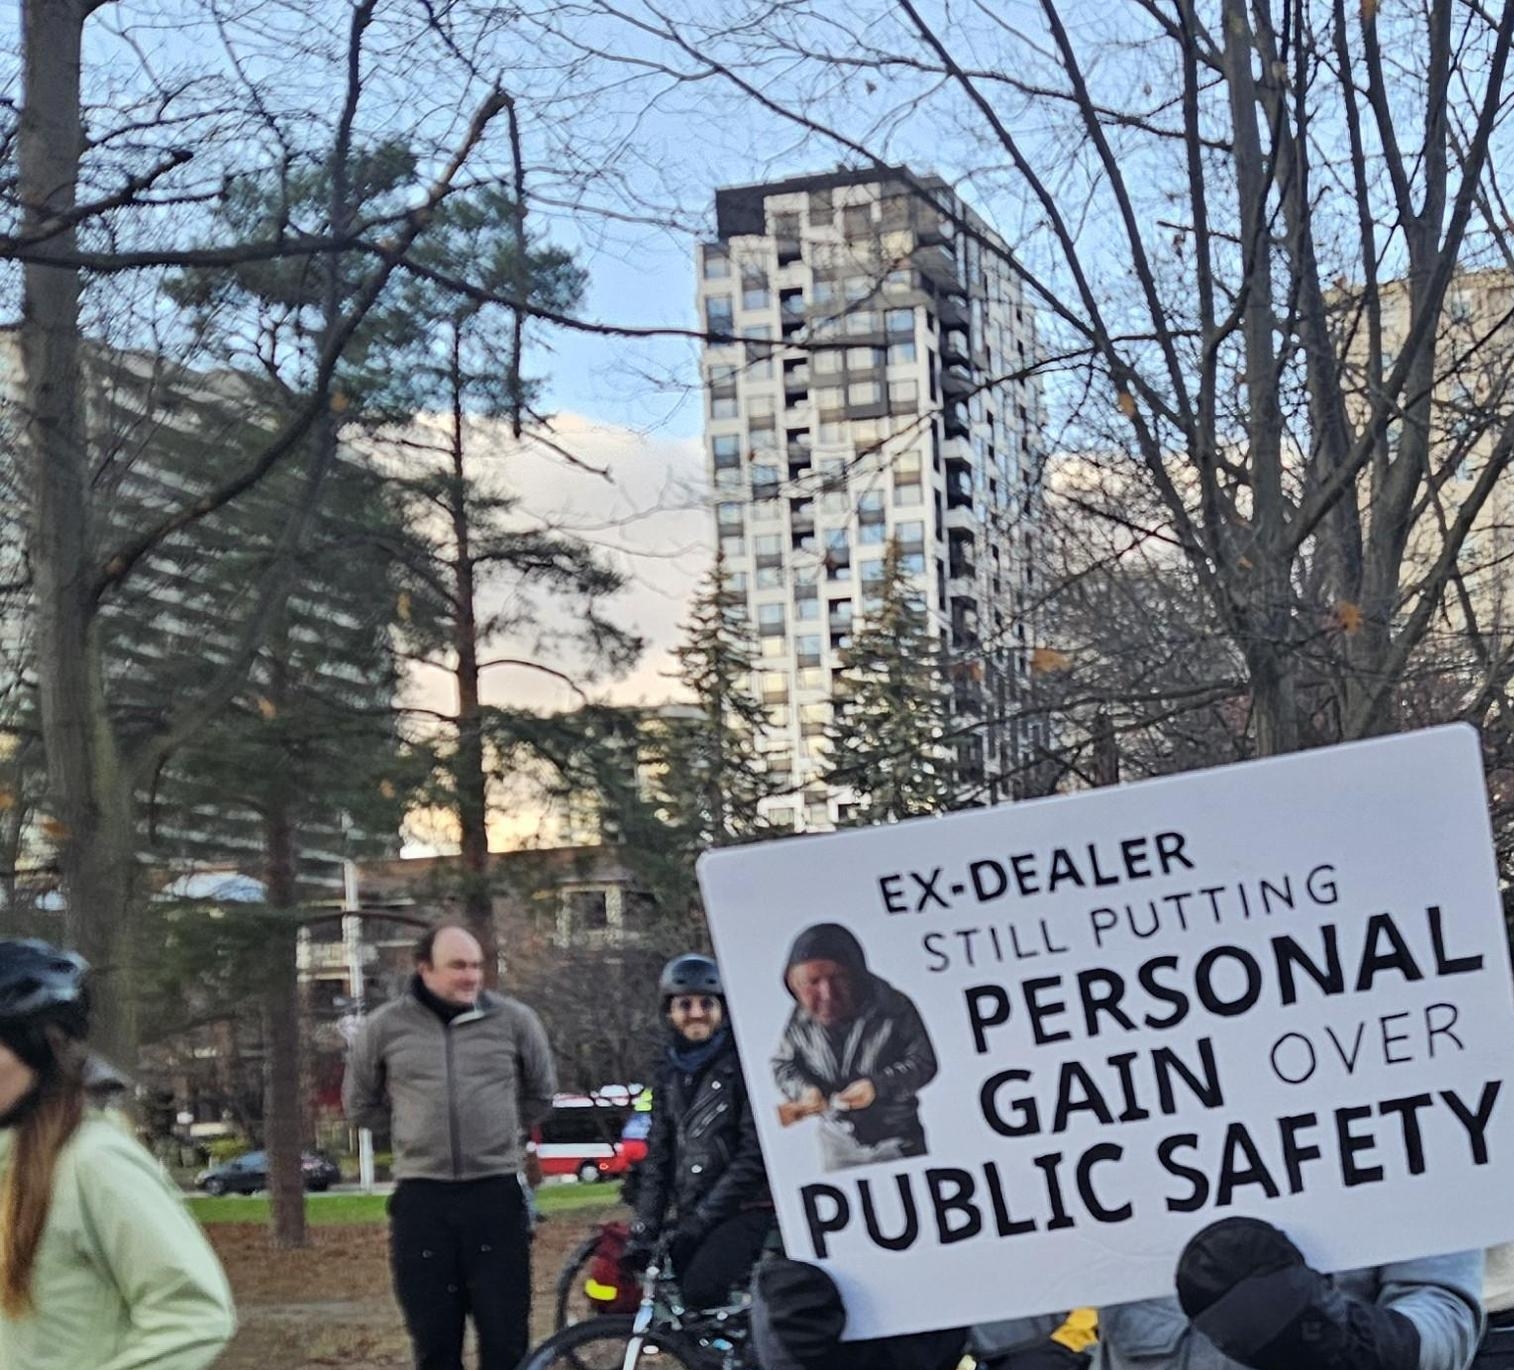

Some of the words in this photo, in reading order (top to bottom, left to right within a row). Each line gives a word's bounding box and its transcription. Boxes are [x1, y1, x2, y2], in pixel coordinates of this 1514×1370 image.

[878, 831, 1195, 915] EX-DEALER
[923, 919, 1068, 973] STILL
[1089, 863, 1339, 948] PUTTING
[963, 905, 1485, 1055] PERSONAL
[979, 1036, 1225, 1138] GAIN
[1269, 1002, 1464, 1085] OVER
[799, 1142, 1134, 1261] PUBLIC
[1156, 1079, 1503, 1213] SAFETY
